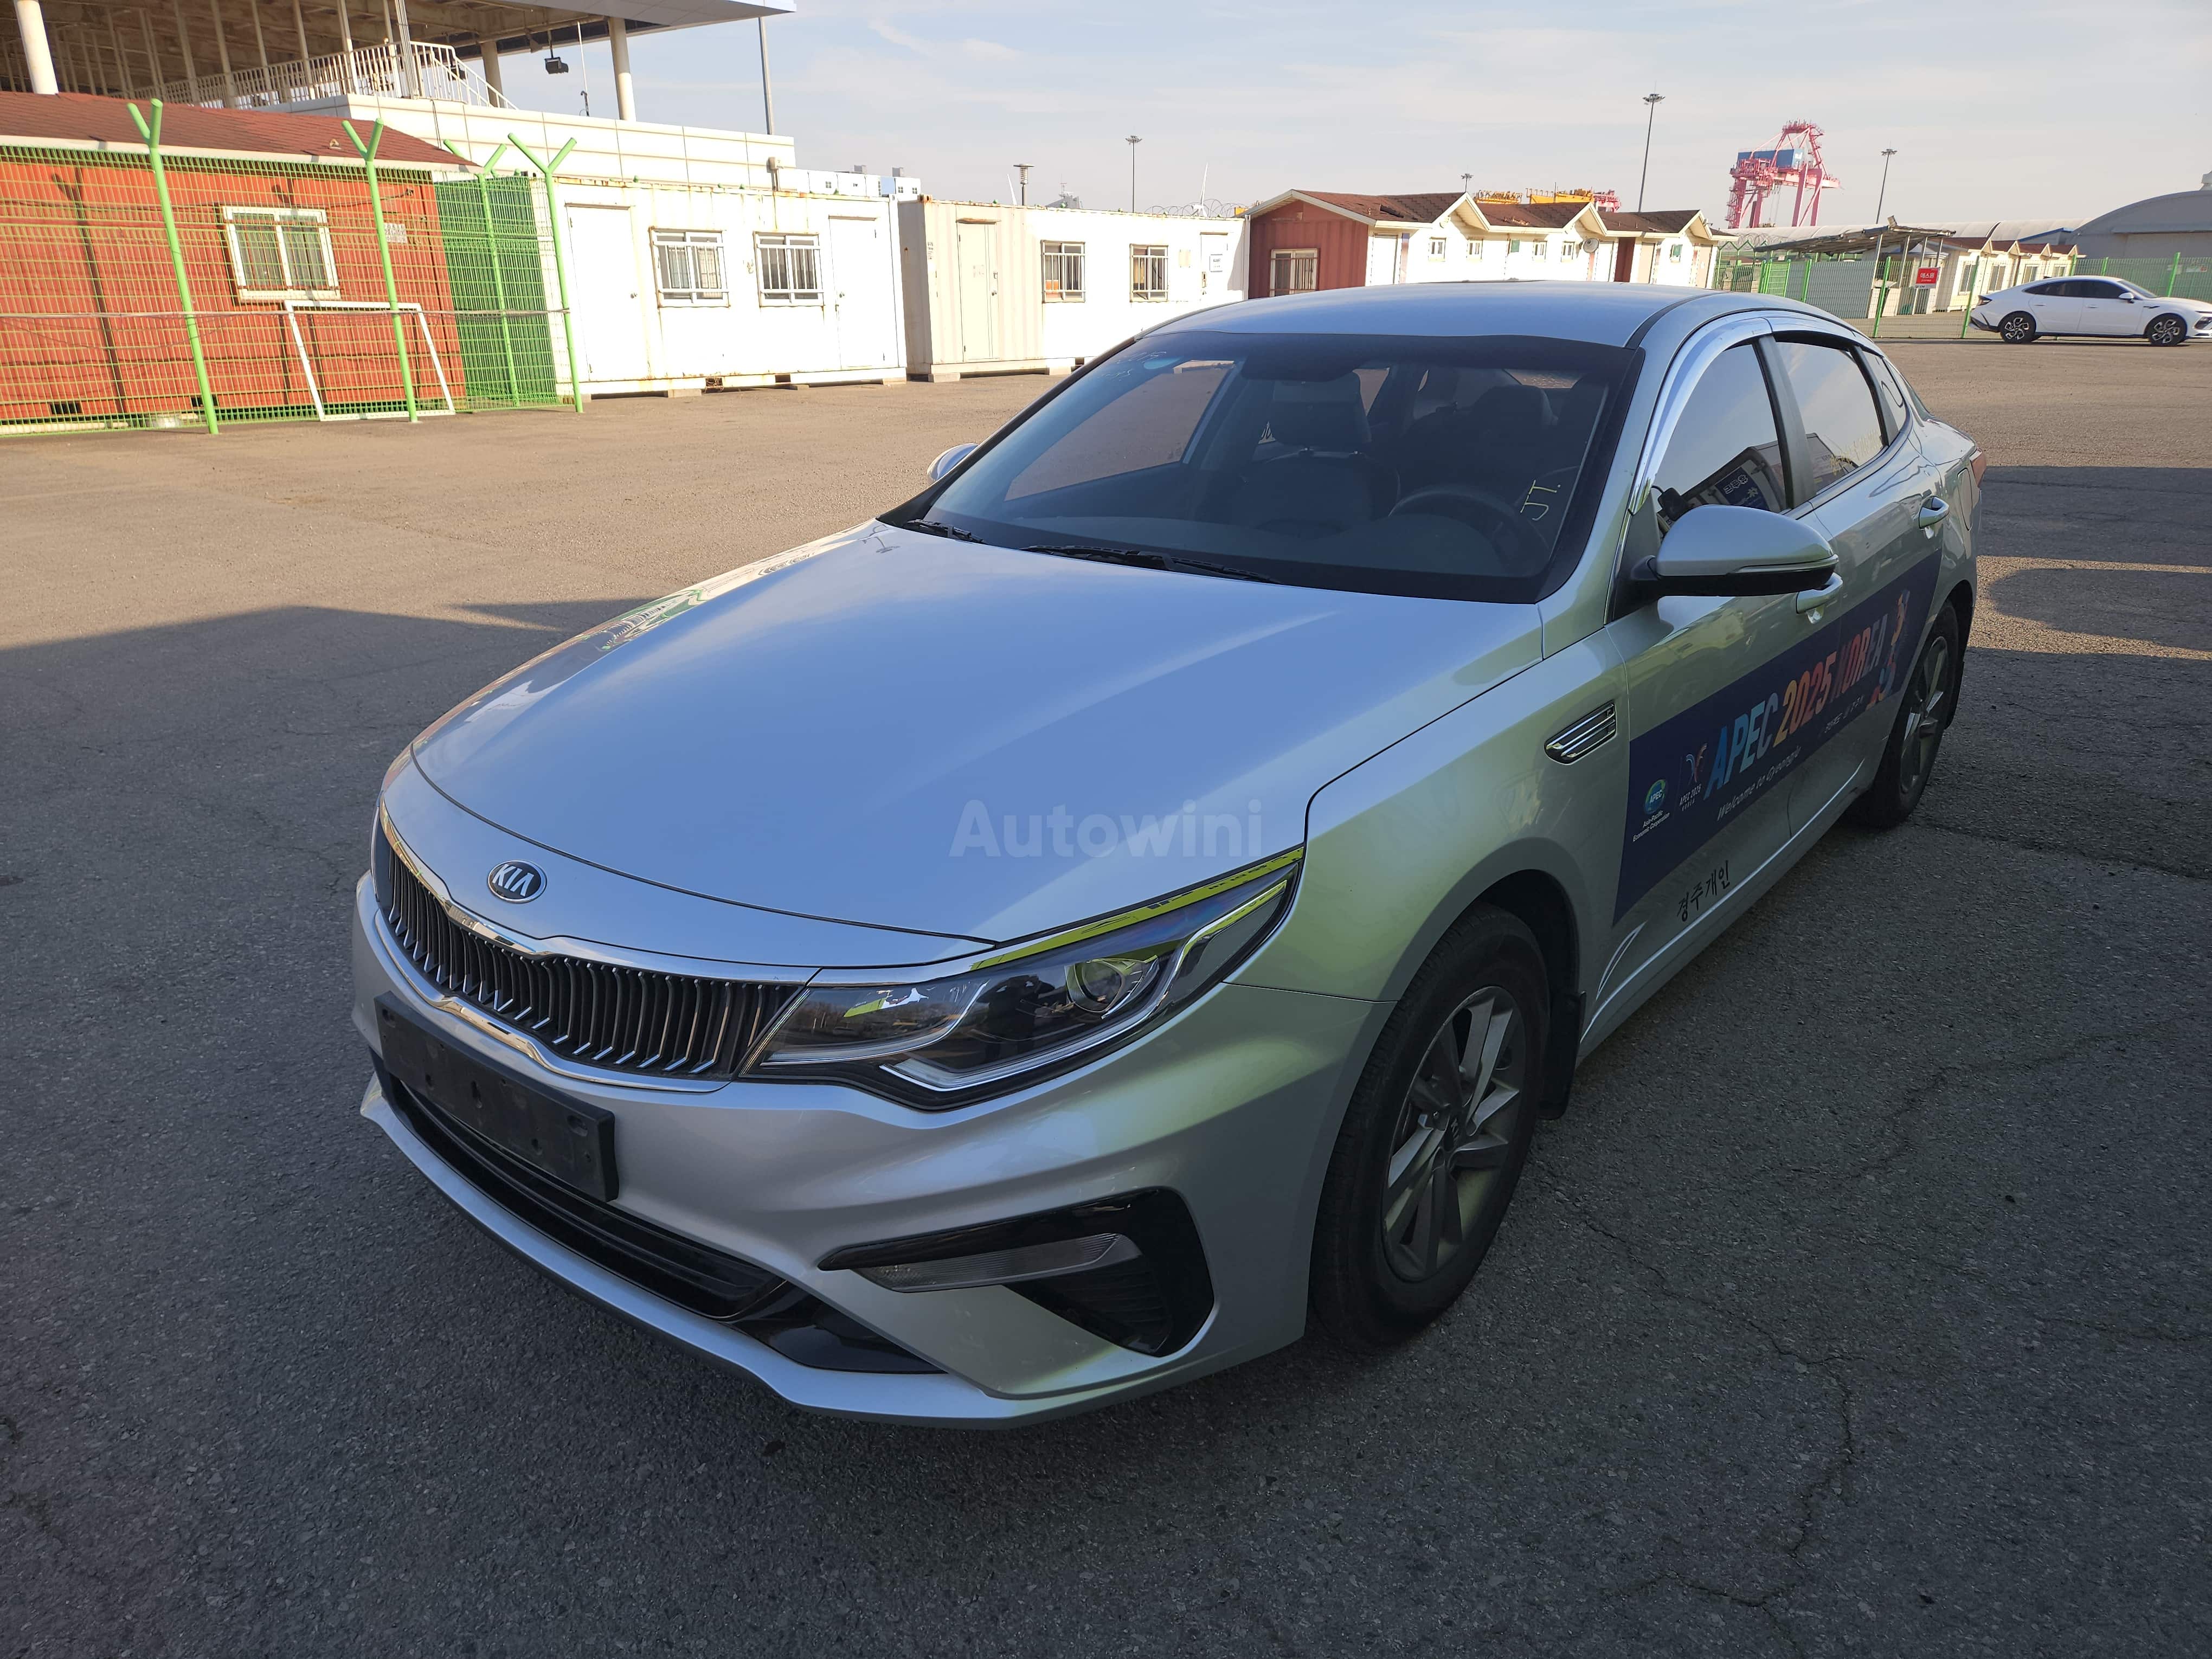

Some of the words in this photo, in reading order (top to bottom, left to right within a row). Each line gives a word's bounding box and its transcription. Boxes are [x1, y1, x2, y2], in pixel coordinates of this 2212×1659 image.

[1703, 693, 1779, 801] APEC
[1773, 651, 1837, 747] 2025
[1830, 613, 1888, 703] KOREA
[1649, 789, 1663, 804] APEC
[1717, 782, 1756, 821] Welcome
[1756, 775, 1766, 789] to
[1632, 826, 1650, 842] Economic
[1649, 812, 1670, 829] Cooperation
[492, 864, 535, 897] KIA
[1676, 859, 1731, 922] 경주개인
